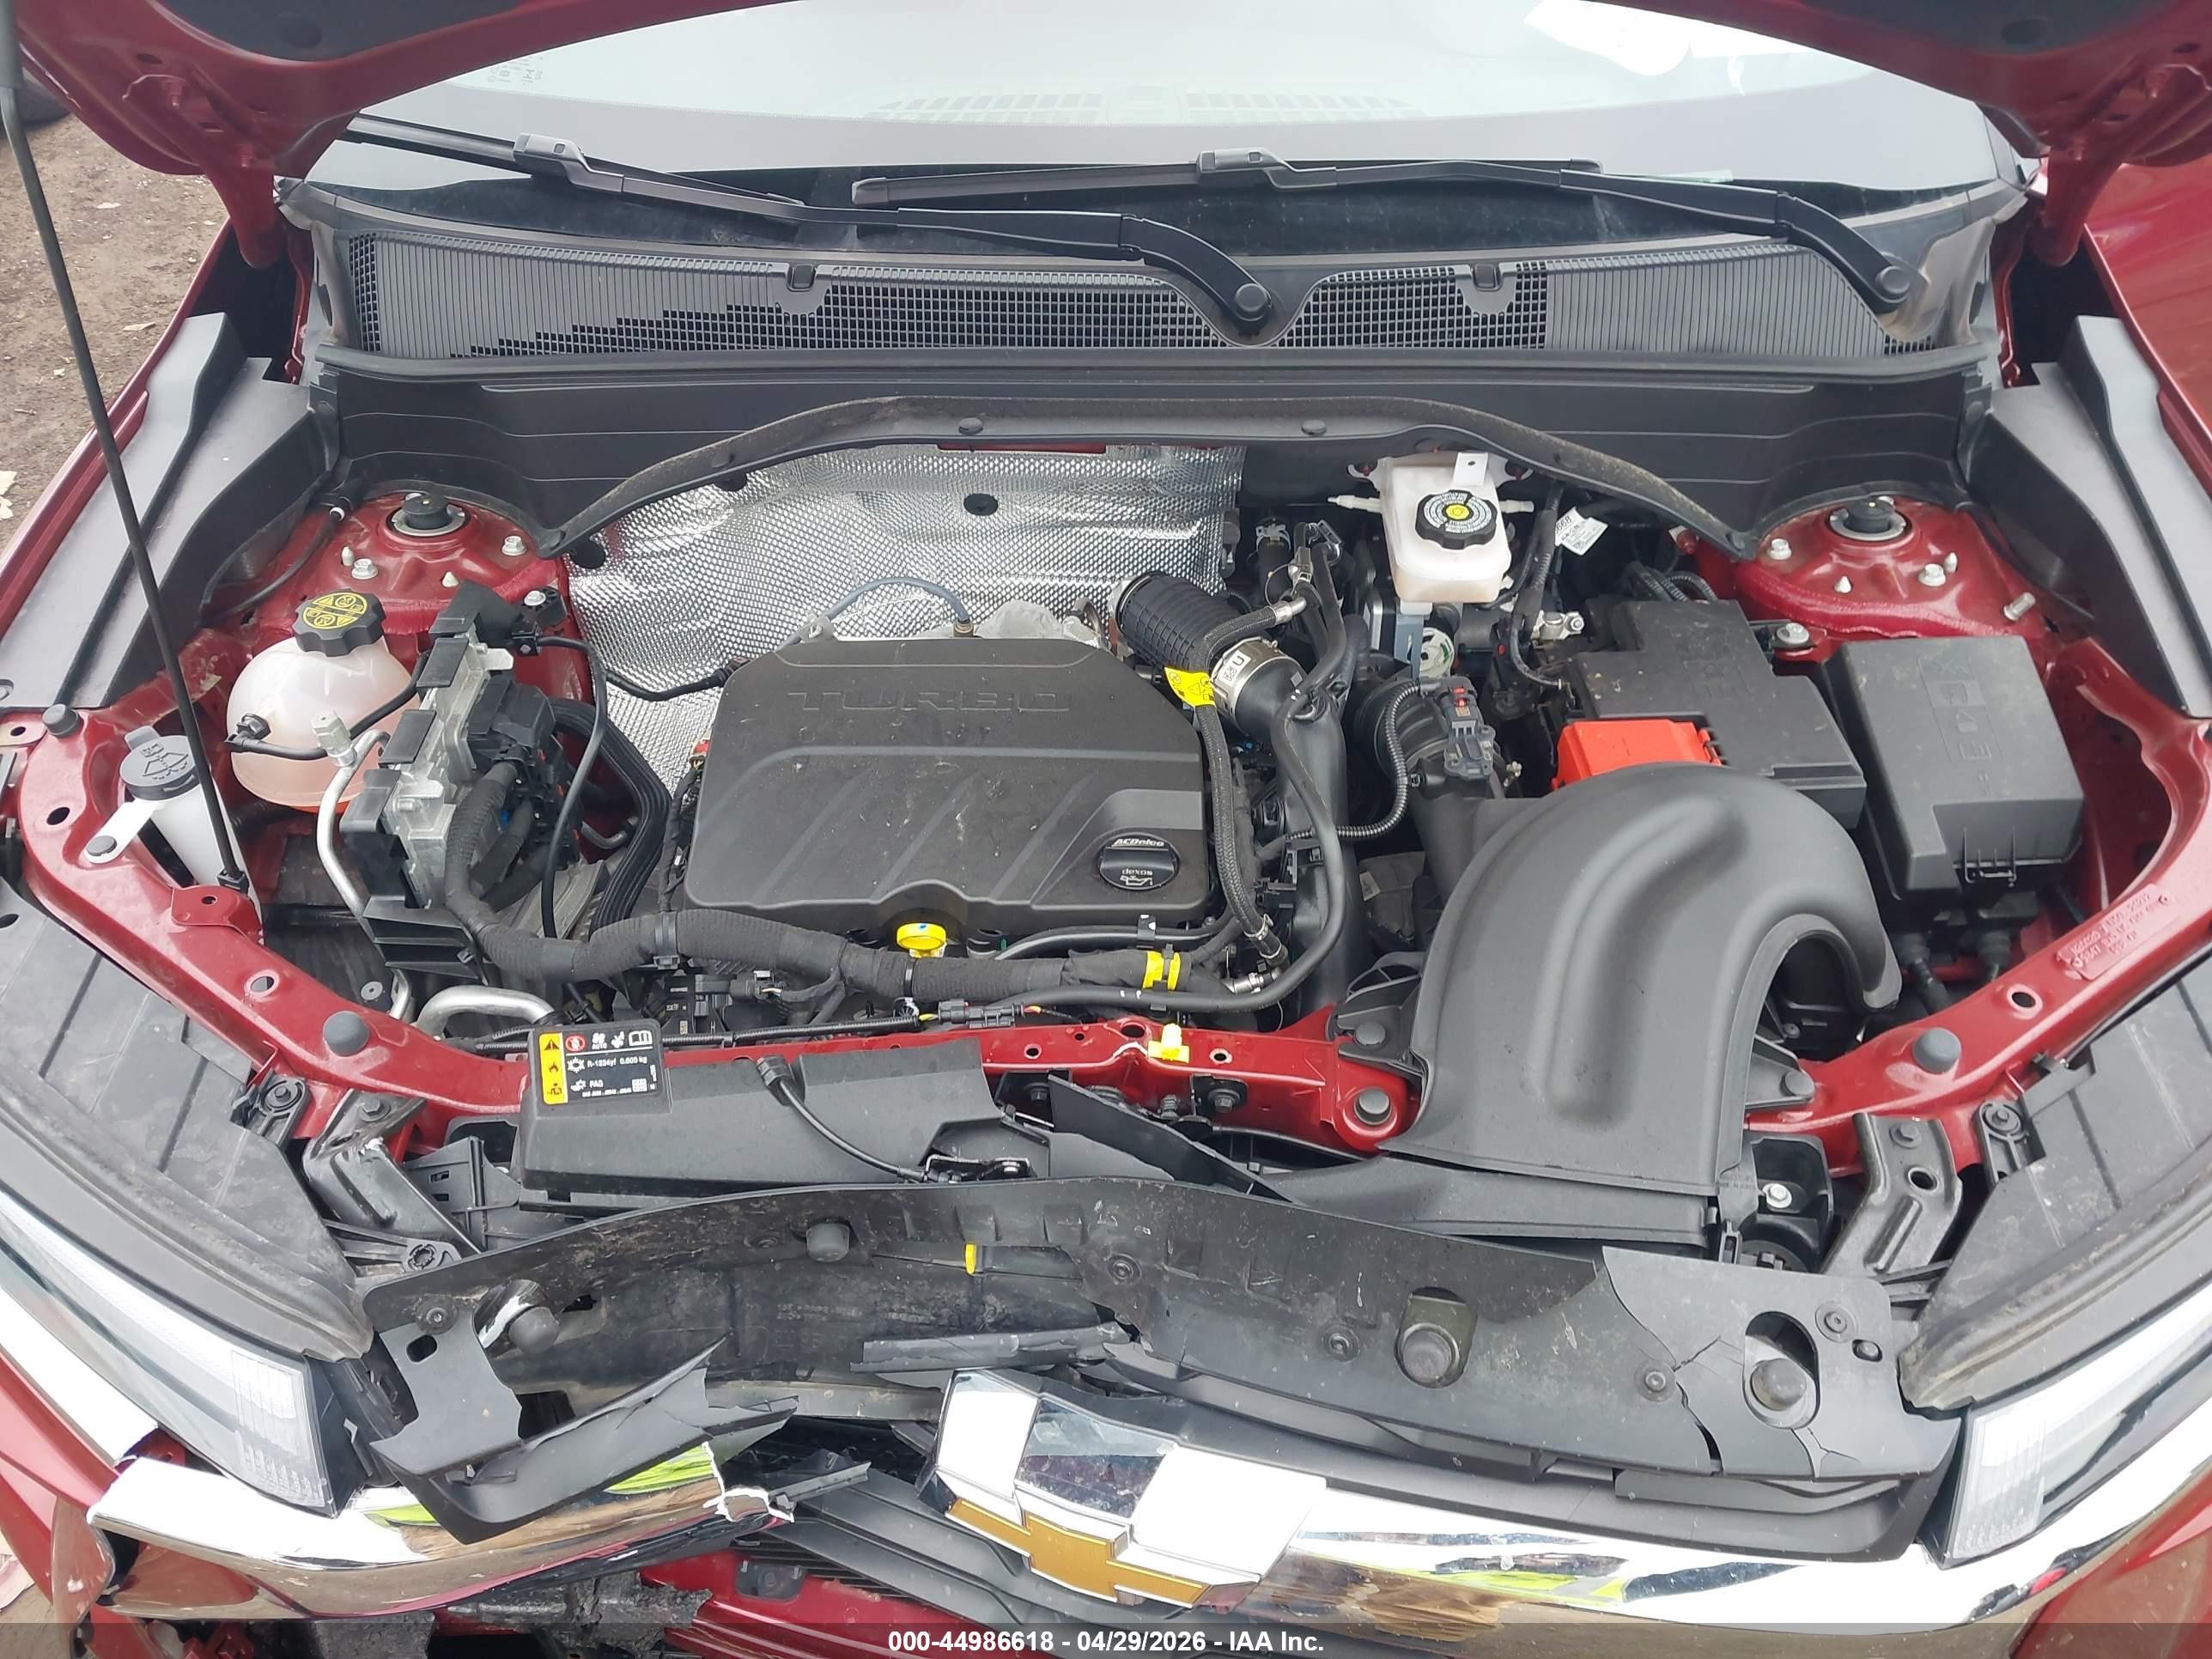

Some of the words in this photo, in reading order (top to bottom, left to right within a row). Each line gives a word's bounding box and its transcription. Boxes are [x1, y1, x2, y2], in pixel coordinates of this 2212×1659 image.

[1232, 655, 1245, 666] U
[787, 691, 1072, 712] TURBO
[1111, 837, 1165, 848] ACDelco
[1121, 867, 1153, 876] dexos
[586, 1057, 617, 1068] R-1234yf
[589, 1079, 604, 1088] PAG
